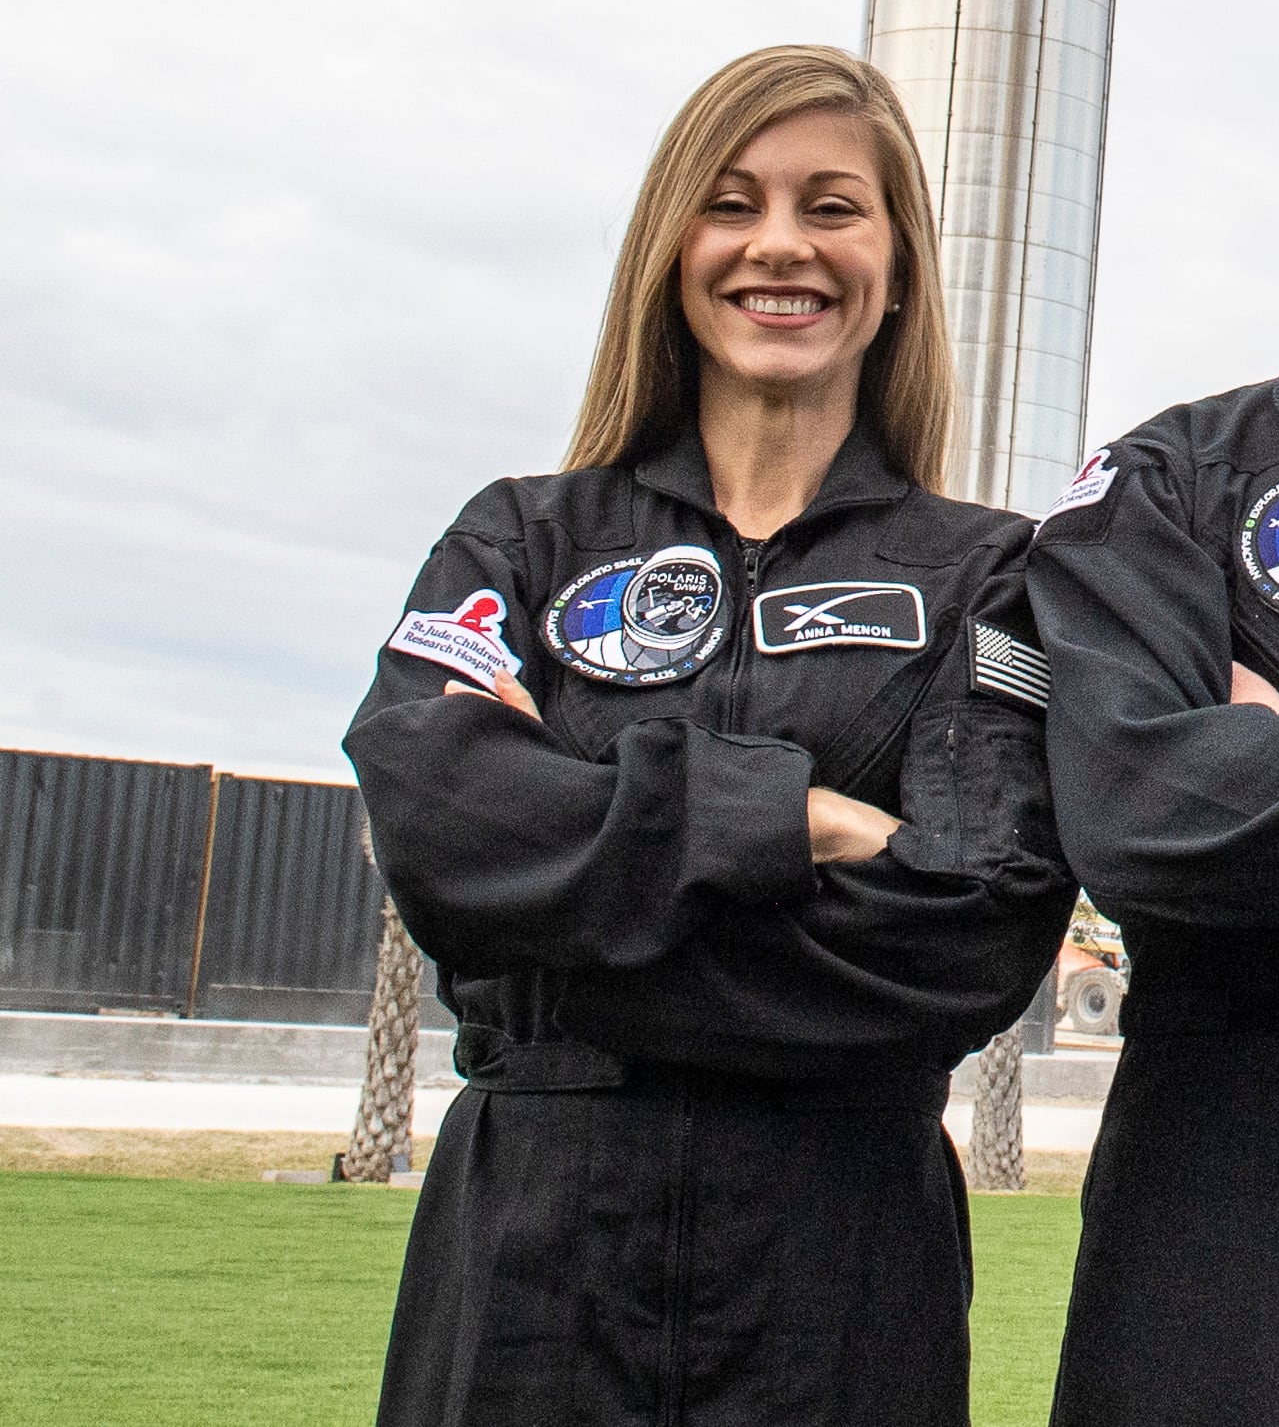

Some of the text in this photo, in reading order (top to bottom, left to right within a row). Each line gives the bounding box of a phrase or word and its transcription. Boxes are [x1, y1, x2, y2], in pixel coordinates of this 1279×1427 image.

[647, 573, 708, 584] POLARIS
[673, 583, 706, 592] DAWN
[424, 626, 452, 640] Jude
[794, 624, 892, 641] ANNA MENON
[403, 631, 496, 678] Research Hospita
